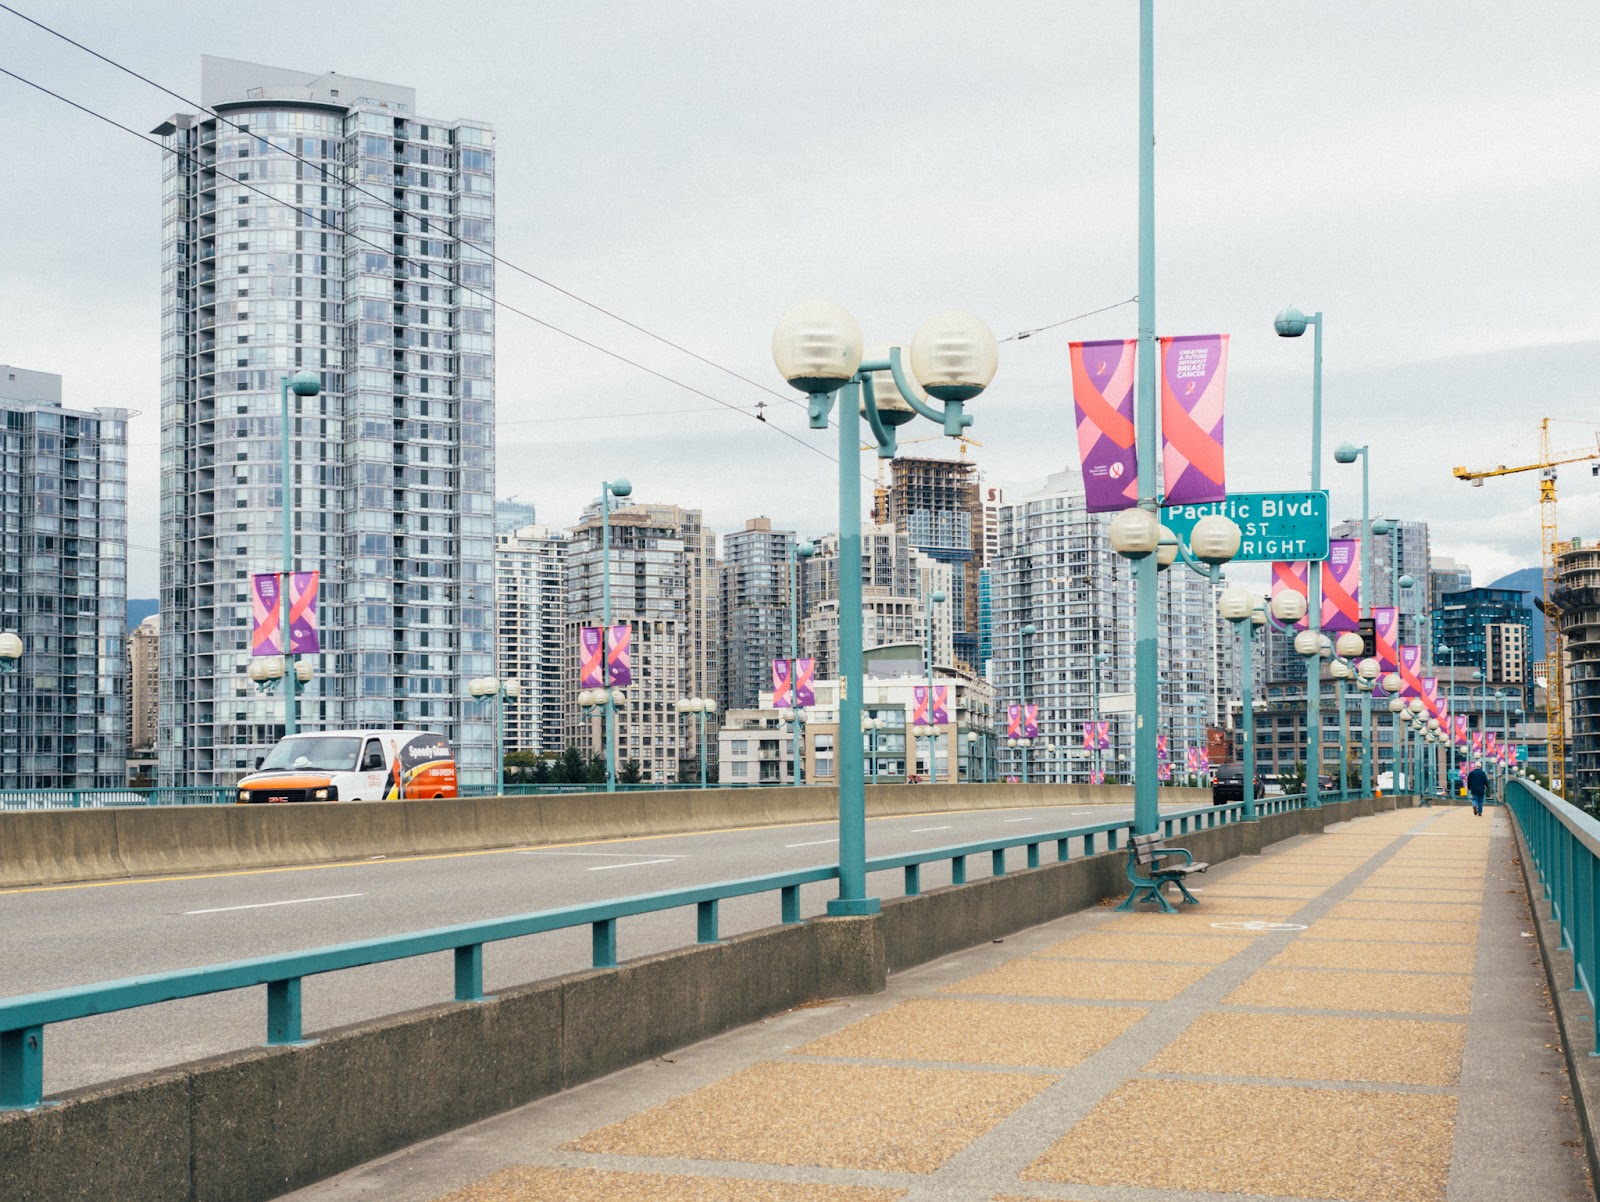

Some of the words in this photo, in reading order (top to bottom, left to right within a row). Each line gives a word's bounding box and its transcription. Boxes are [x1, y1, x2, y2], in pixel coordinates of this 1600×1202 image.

[1178, 358, 1206, 366] WITHOUT
[1177, 364, 1206, 372] BREAST
[1176, 370, 1205, 378] CANCER
[1169, 501, 1249, 520] Pacific
[1262, 499, 1318, 517] Blvd.
[1243, 540, 1306, 554] RIGHT
[409, 745, 432, 759] Speedy
